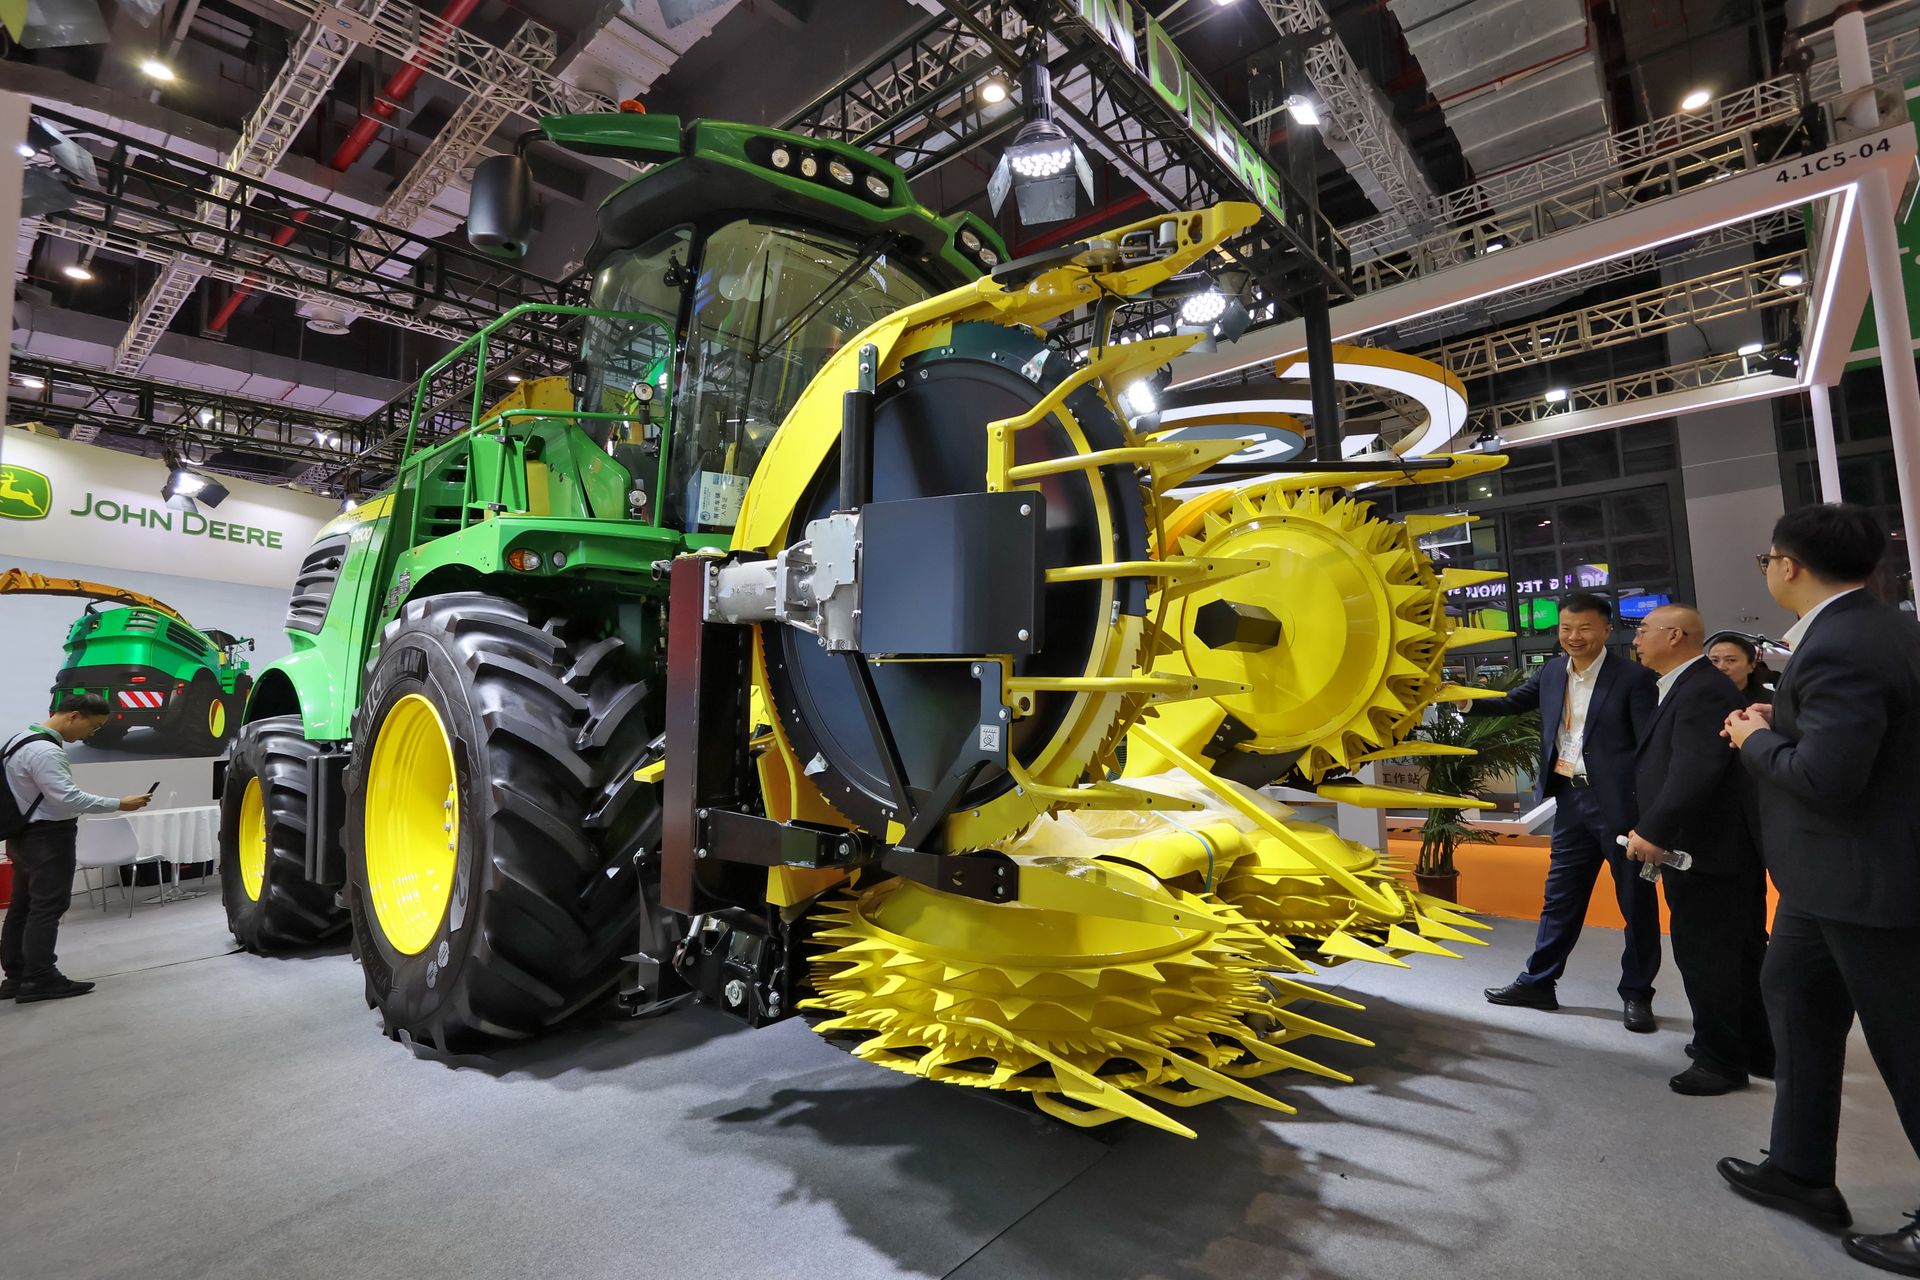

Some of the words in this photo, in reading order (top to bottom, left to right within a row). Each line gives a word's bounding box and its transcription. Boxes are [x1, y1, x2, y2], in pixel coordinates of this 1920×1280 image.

[1145, 11, 1286, 227] DEERE
[1775, 137, 1892, 183] 4.1C5-04
[70, 492, 172, 531] JOHN
[182, 510, 283, 550] DEERE
[1382, 772, 1420, 785] 工作站
